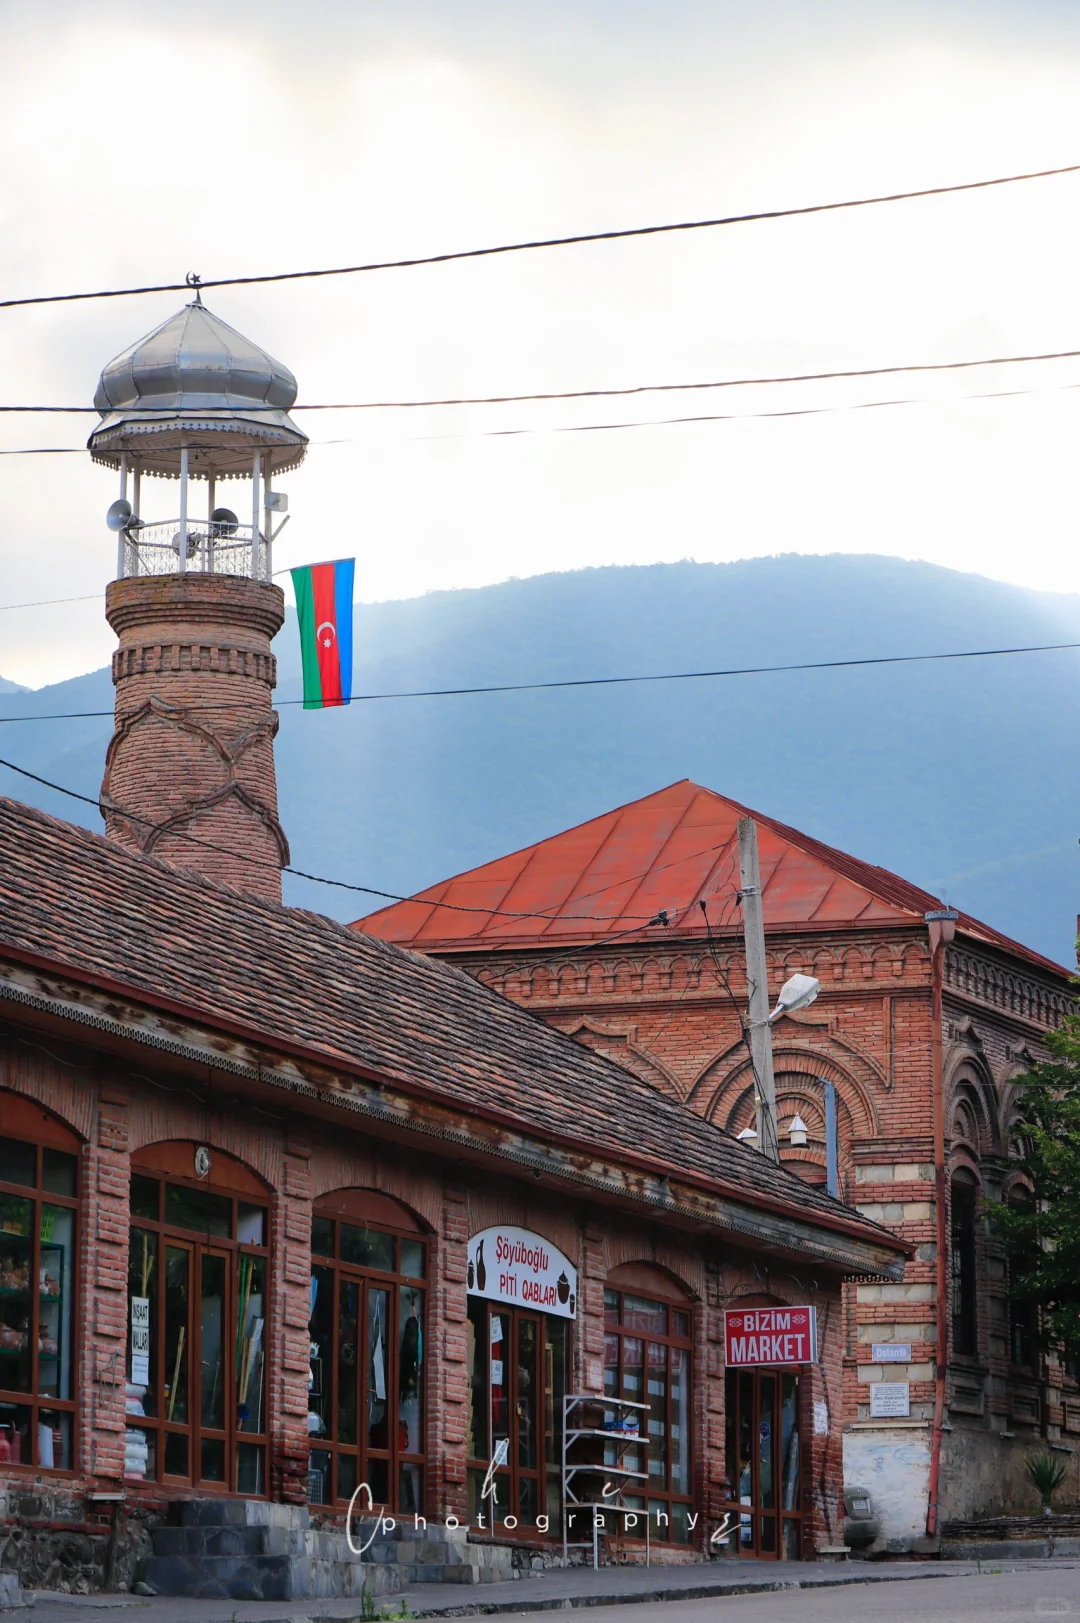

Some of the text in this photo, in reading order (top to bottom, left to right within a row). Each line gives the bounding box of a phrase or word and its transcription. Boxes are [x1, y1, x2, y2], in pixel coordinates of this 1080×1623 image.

[495, 1235, 549, 1274] Şöyüboğlu
[499, 1270, 558, 1307] PİTİ QABLARI
[743, 1310, 791, 1332] BİZİM
[730, 1333, 806, 1363] MARKET
